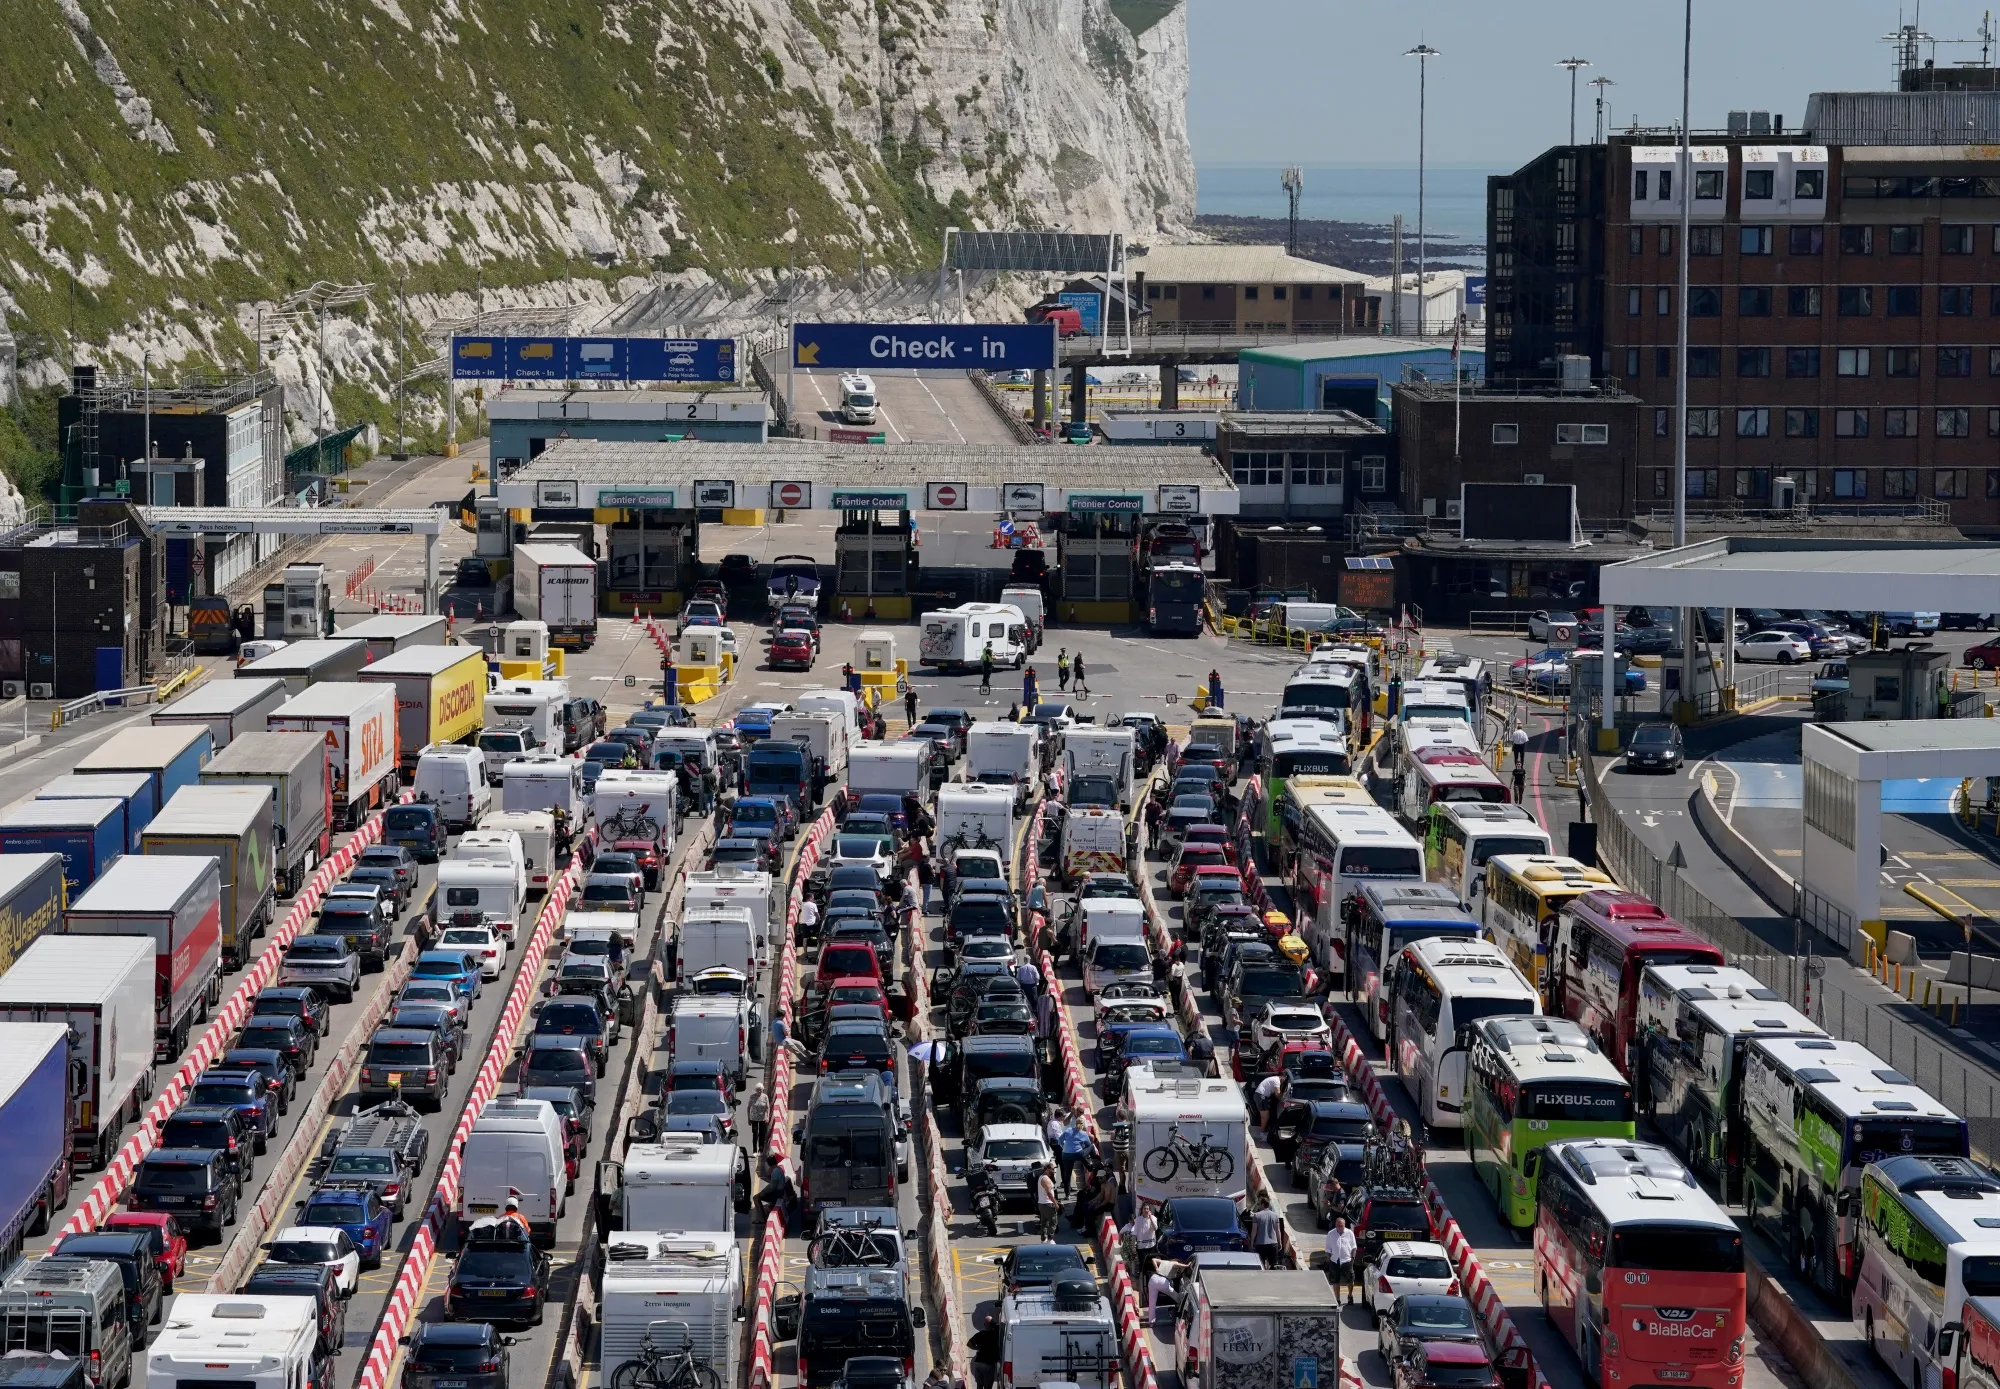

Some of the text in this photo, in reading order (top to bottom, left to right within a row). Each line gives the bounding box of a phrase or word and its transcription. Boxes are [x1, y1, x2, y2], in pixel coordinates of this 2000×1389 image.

[869, 335, 956, 359] Check
[982, 336, 1006, 359] in
[456, 368, 481, 376] Check
[516, 369, 540, 377] Check
[560, 404, 567, 417] 1
[687, 404, 697, 418] 2
[1174, 423, 1186, 436] 3
[602, 496, 671, 504] Frontier Control
[836, 497, 904, 506] Frontier Control
[1072, 500, 1140, 509] Frontier Control
[546, 577, 589, 585] JCARRION
[1343, 575, 1369, 583] PLEASE
[1345, 589, 1388, 597] DOCUMENTS
[438, 679, 475, 726] DISCORDIA
[1292, 764, 1330, 773] FLiXBUS
[1535, 1094, 1616, 1106] FLiXBUS.com
[1626, 1273, 1635, 1283] 90
[1638, 1273, 1650, 1283] 100
[859, 1307, 893, 1315] platinum
[1660, 1309, 1689, 1318] VDL
[1648, 1322, 1716, 1338] BlaBlaCar
